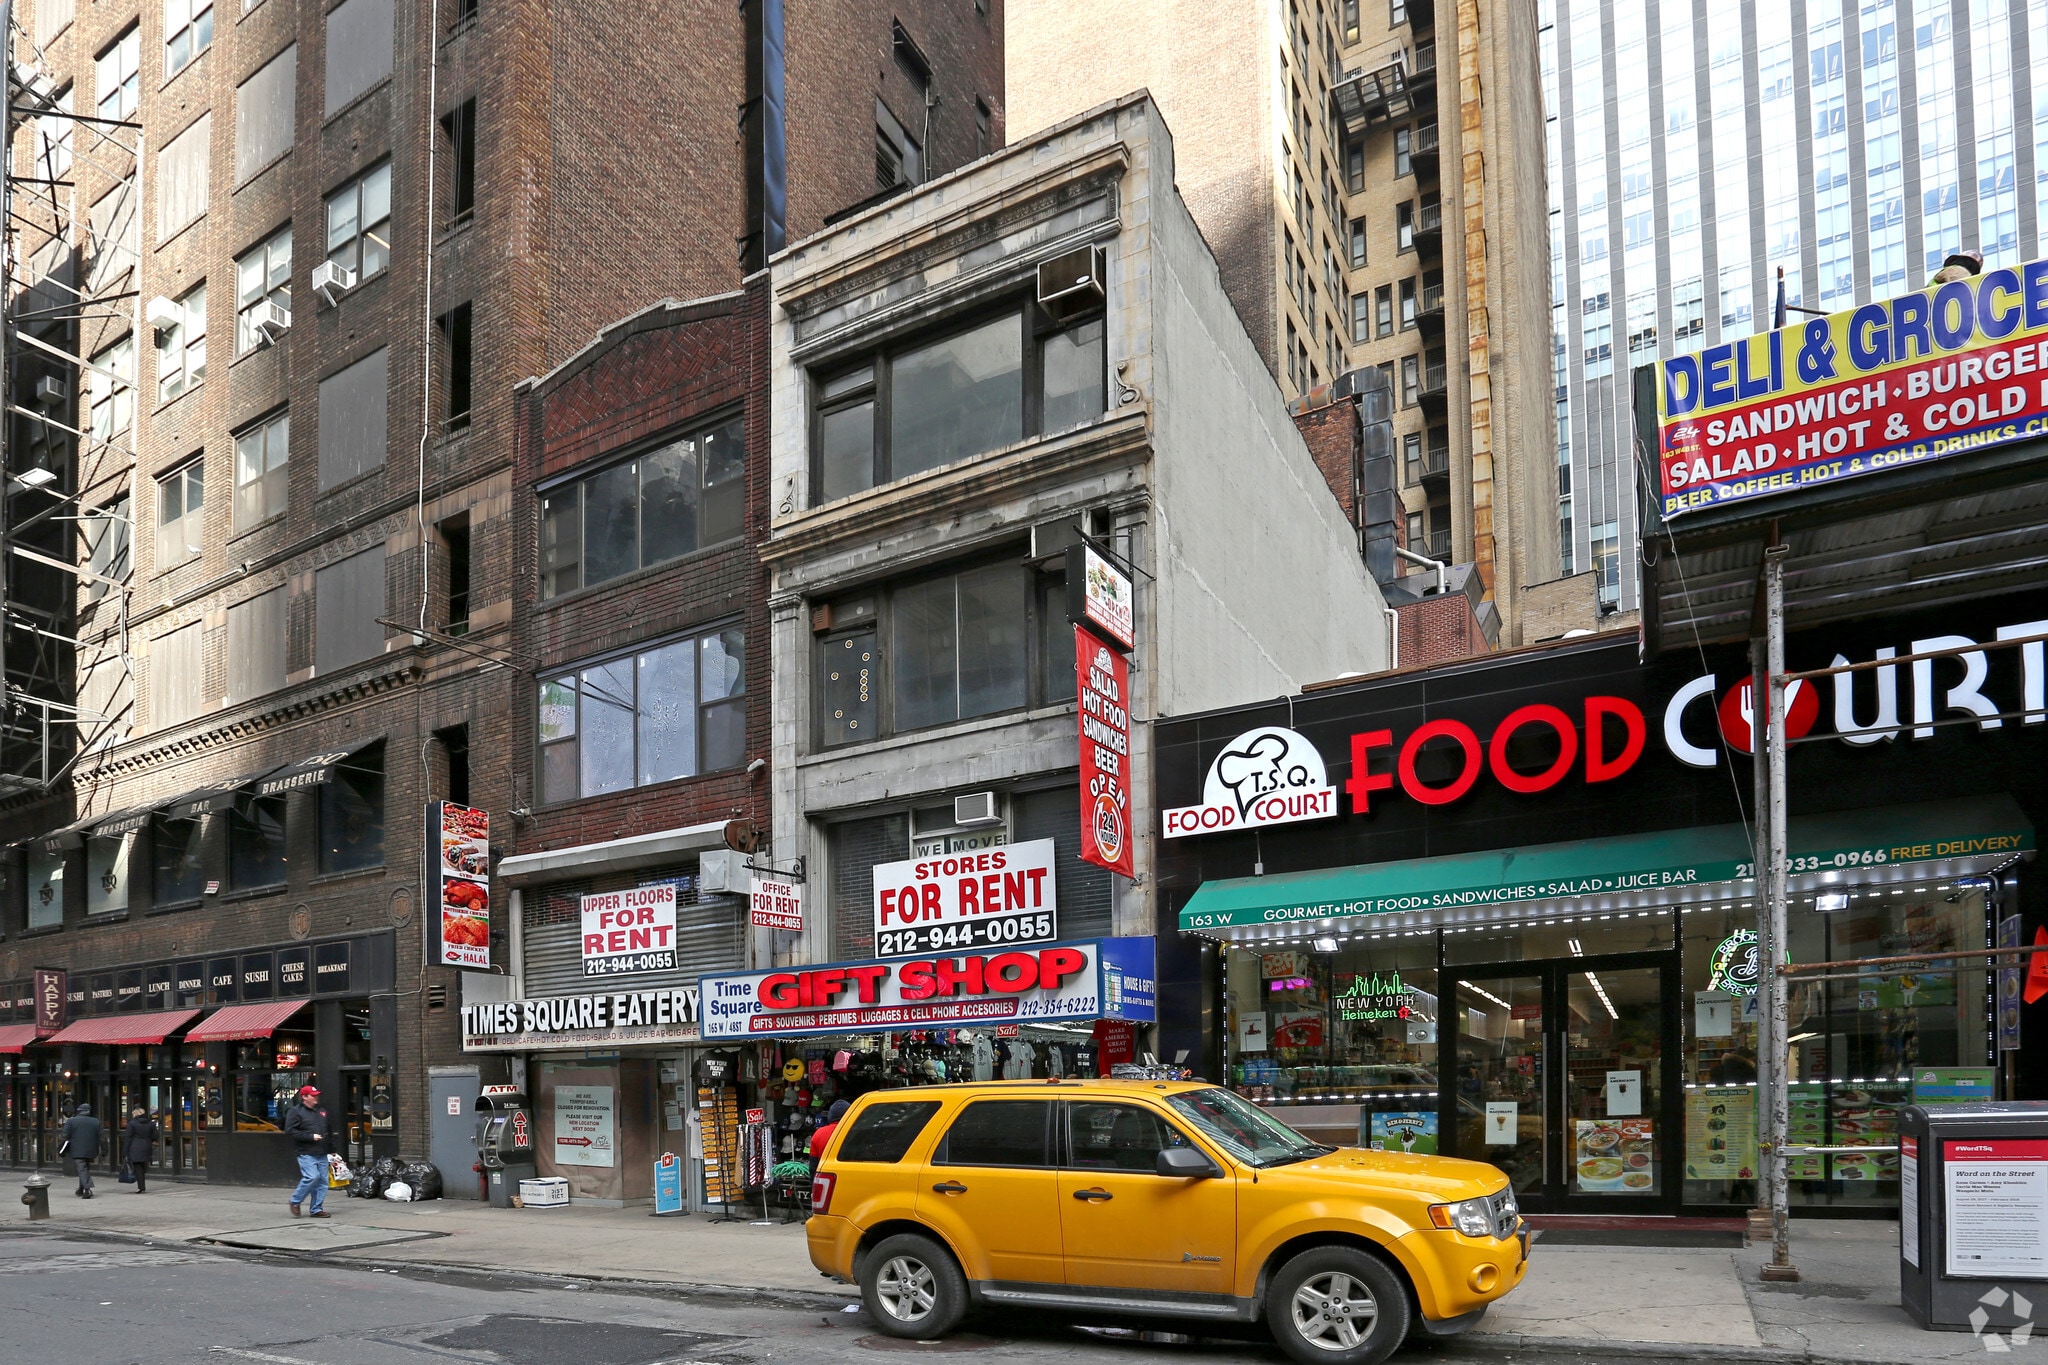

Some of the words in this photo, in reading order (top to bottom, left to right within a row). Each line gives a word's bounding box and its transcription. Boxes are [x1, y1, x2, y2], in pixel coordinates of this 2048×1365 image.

[1664, 329, 1784, 419] DELI
[1797, 317, 1838, 385] &
[1707, 380, 1886, 447] SANDWICH
[1670, 443, 1776, 488] SALAD
[1797, 420, 1870, 460] HOT
[1884, 412, 1910, 441] &
[1923, 386, 2026, 431] COLD
[1665, 488, 1713, 512] BEER
[1718, 472, 1793, 499] COFFEE
[1801, 462, 1842, 483] HOT
[1850, 458, 1864, 473] &
[1871, 443, 1926, 467] COLD
[1934, 425, 2016, 455] DRINKS
[1090, 666, 1118, 702] SALAD
[1082, 686, 1101, 714] HOT
[1103, 699, 1126, 731] FOOD
[1083, 713, 1127, 756] SANDWICHES
[1094, 745, 1119, 777] BEER
[1345, 695, 1647, 814] FOOD
[262, 769, 325, 794] BRASSERIE
[1250, 765, 1316, 792] T.S.Q.
[1090, 774, 1126, 810] OPEN
[190, 800, 210, 814] BAR
[1168, 806, 1235, 833] FOOD
[1255, 791, 1331, 820] COURT
[96, 815, 145, 836] BRASSERIE
[1102, 812, 1113, 830] 24
[1100, 829, 1117, 846] HOURS
[917, 844, 941, 857] WE
[915, 851, 1006, 880] STORES
[763, 882, 791, 896] OFFICE
[1189, 915, 1212, 927] 163
[1216, 914, 1233, 926] W
[1264, 904, 1335, 921] GOURMET
[1344, 901, 1373, 914] HOT
[1378, 896, 1421, 910] FOOD
[1432, 885, 1535, 906] SANDWICHES
[1548, 879, 1602, 895] SALAD
[1615, 873, 1658, 888] JUICE
[1662, 869, 1697, 883] BAR
[1891, 845, 1931, 860] FREE
[1937, 834, 2022, 855] DELIVERY
[583, 895, 620, 912] UPPER
[625, 887, 673, 907] FLOORS
[753, 893, 772, 911] FOR
[776, 897, 799, 914] RENT
[880, 883, 942, 926] FOR
[959, 867, 1047, 916] RENT
[600, 907, 654, 929] FOR
[754, 913, 800, 928] 212-944-0055
[584, 925, 673, 954] RENT
[880, 914, 1050, 954] 212-944-0055
[281, 962, 305, 973] CHEESE
[317, 963, 347, 974] BREAKFAST
[463, 953, 488, 964] HALAL
[587, 952, 672, 974] 212-944-0055
[1263, 952, 1294, 972] POP
[178, 979, 201, 989] DINNER
[213, 975, 232, 986] CAFE
[245, 971, 269, 983] SUSHI
[283, 973, 303, 983] CAKES
[899, 947, 1084, 1000] SHOP
[1123, 975, 1138, 991] HOUSE
[1143, 979, 1154, 993] GIFTS
[43, 975, 59, 1020] HAPPY
[92, 989, 112, 999] PASTRIES
[148, 982, 170, 993] LUNCH
[715, 981, 751, 997] Time
[757, 966, 887, 1010] GIFT
[17, 998, 34, 1007] DINNER
[461, 1003, 518, 1034] TIMES
[523, 996, 606, 1033] SQUARE
[614, 990, 700, 1026] EATERY
[710, 999, 762, 1018] Square
[1021, 996, 1096, 1017] 212-354-6222
[1336, 997, 1371, 1010] NEW
[1375, 995, 1415, 1008] YORK
[753, 1017, 773, 1029] GIFTS
[776, 1015, 815, 1028] SOUVENIRS
[819, 1012, 857, 1025] PERFUMES
[860, 1009, 901, 1023] LUGGAGES
[903, 1009, 909, 1020] &
[911, 1006, 930, 1019] CELL
[932, 1004, 960, 1018] PHONE
[962, 1002, 1014, 1016] ACCESORIES
[1342, 1008, 1397, 1021] Heineken
[627, 1031, 647, 1039] JUICE
[651, 1029, 664, 1037] BAR
[708, 1023, 718, 1034] 165
[999, 1026, 1017, 1035] Sale
[1867, 1082, 1906, 1091] Desserts
[749, 1112, 764, 1122] Sale
[513, 1112, 528, 1147] ATM
